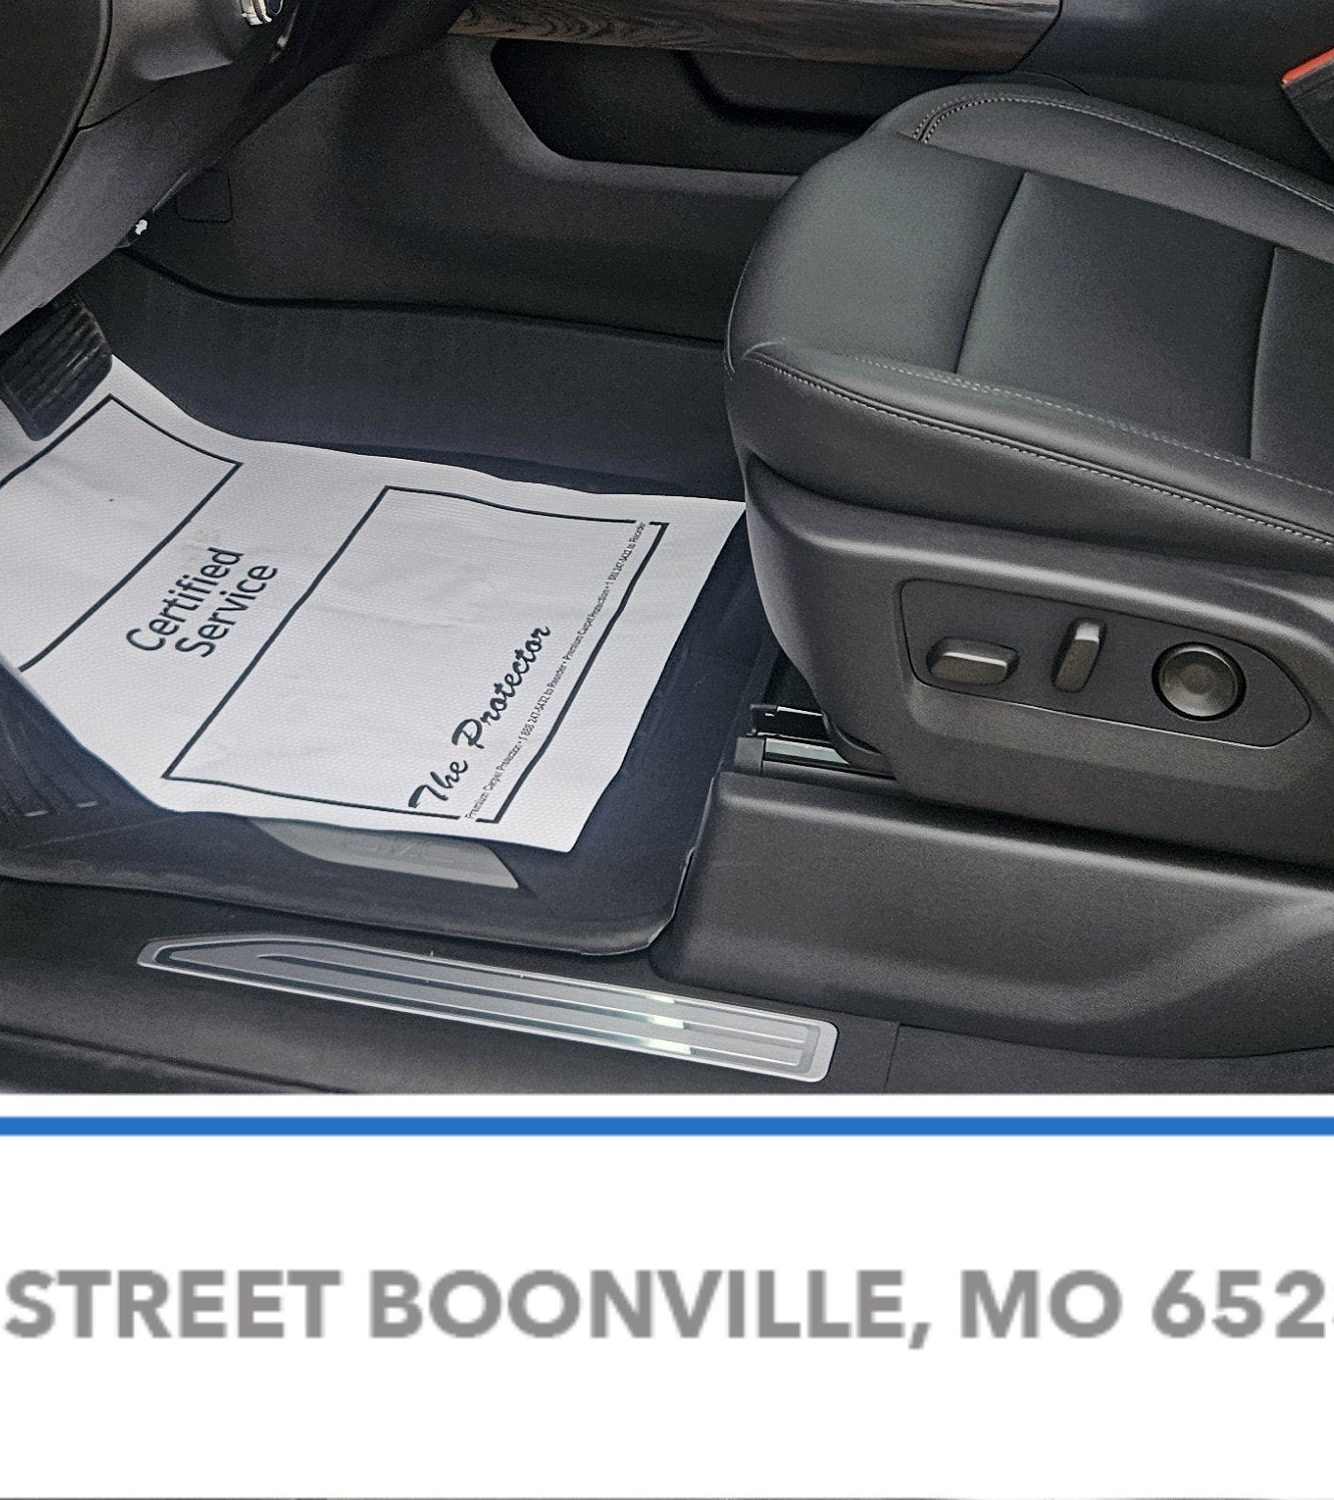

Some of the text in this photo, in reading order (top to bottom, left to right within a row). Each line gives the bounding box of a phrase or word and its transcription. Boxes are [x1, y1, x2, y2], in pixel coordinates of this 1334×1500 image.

[126, 546, 245, 651] Certified
[174, 565, 278, 658] Service
[408, 626, 551, 808] The Protector
